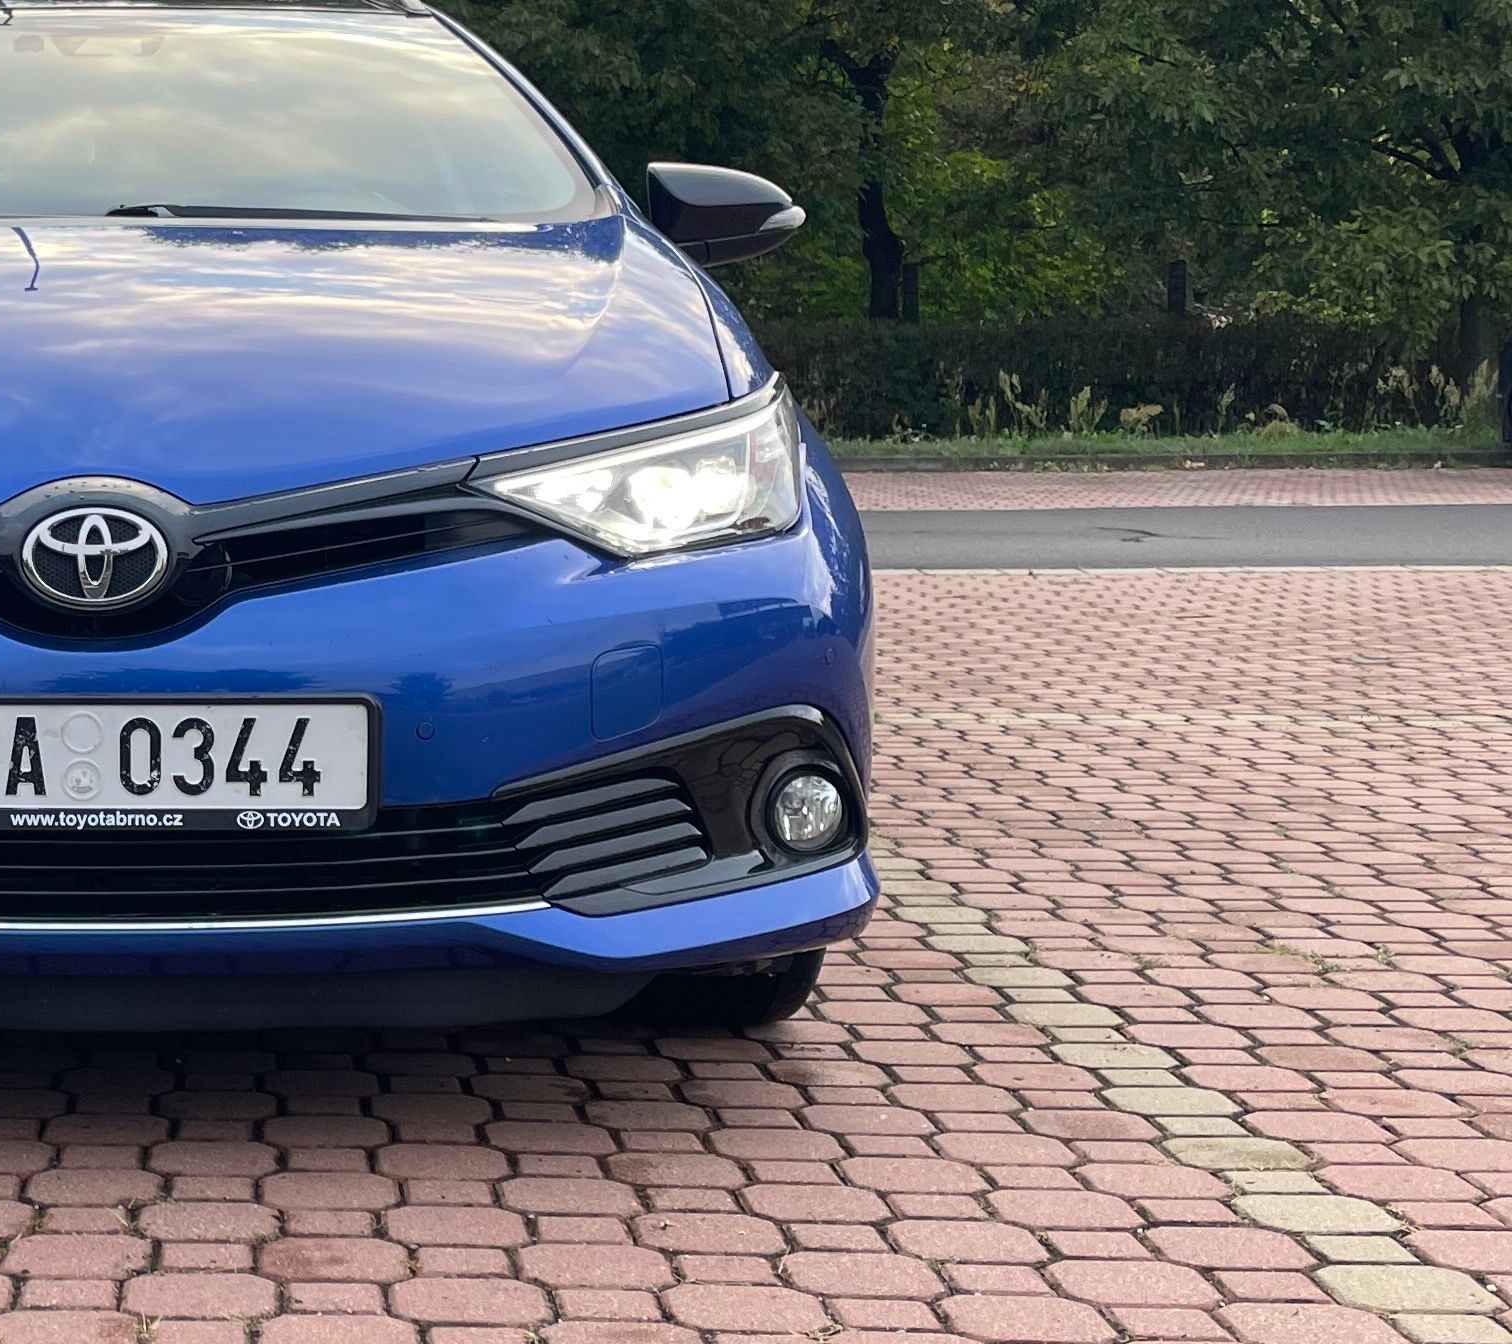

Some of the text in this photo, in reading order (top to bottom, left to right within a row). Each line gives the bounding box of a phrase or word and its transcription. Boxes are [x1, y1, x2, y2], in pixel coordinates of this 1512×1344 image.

[119, 717, 321, 797] 0344
[10, 811, 184, 830] www.toyotabrno.cz
[266, 812, 341, 828] TOYOTA
